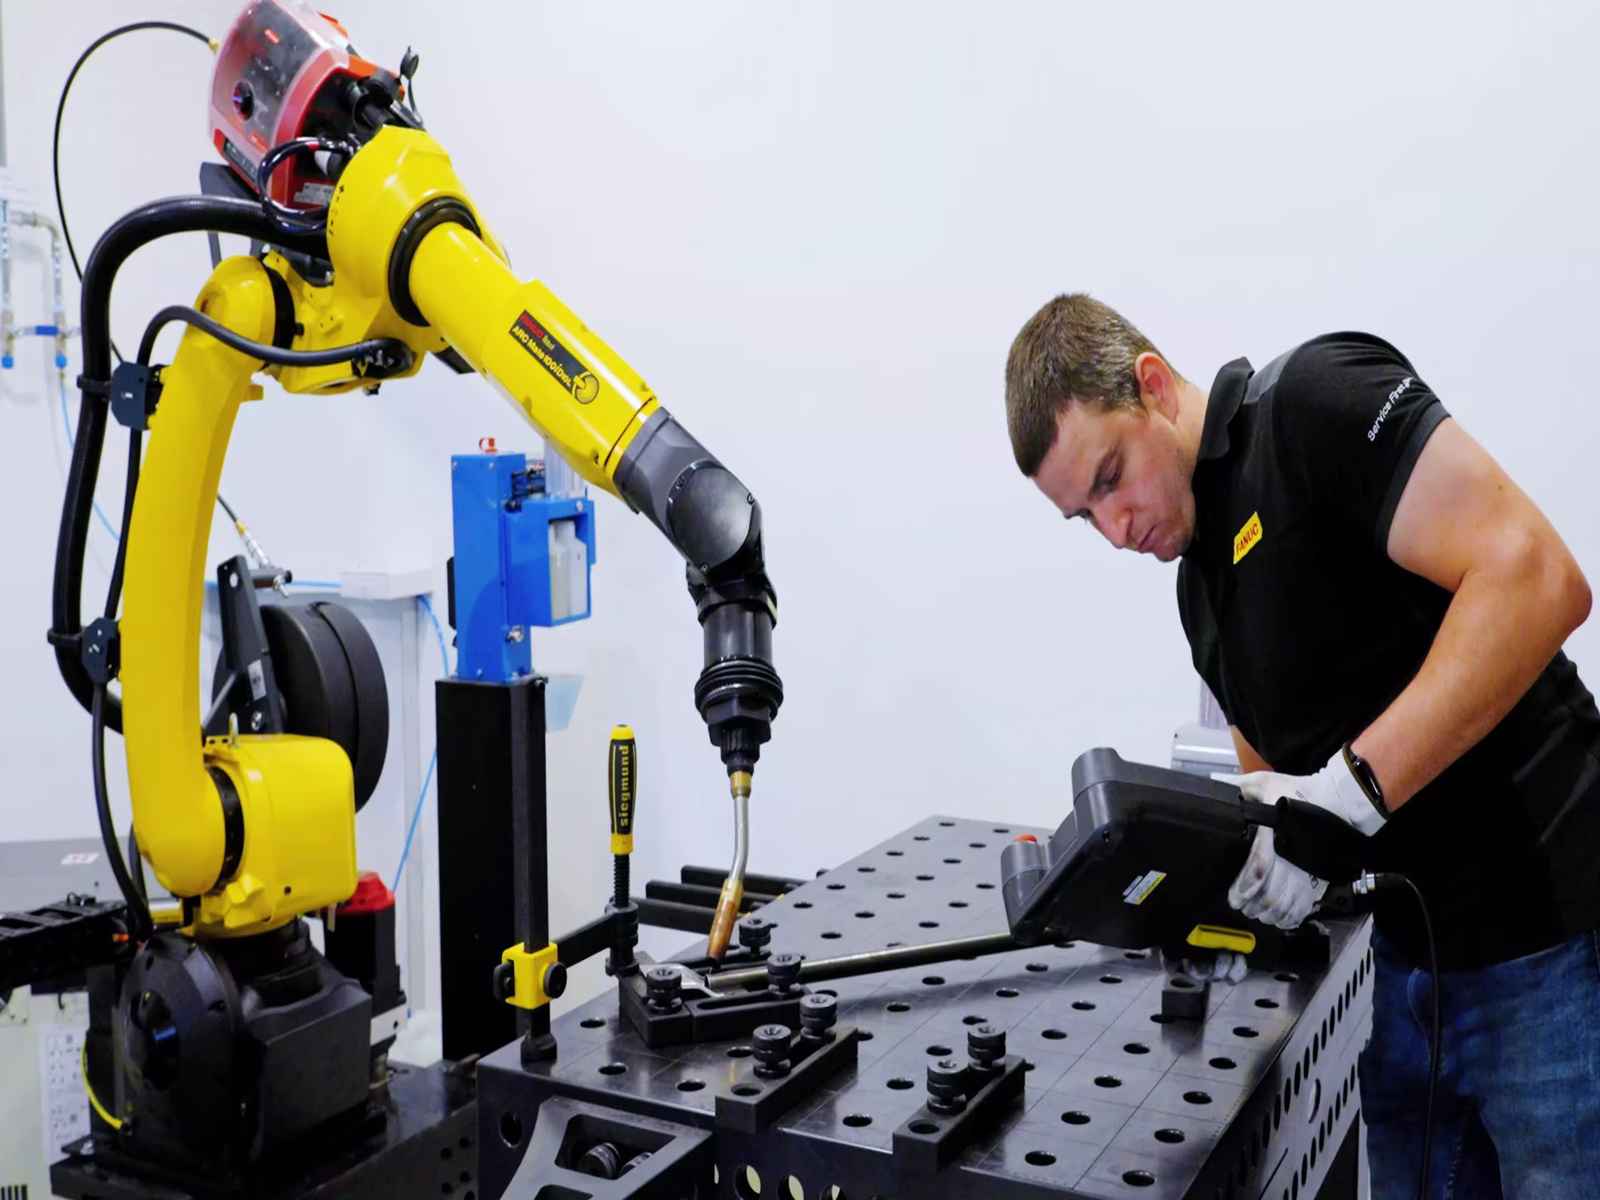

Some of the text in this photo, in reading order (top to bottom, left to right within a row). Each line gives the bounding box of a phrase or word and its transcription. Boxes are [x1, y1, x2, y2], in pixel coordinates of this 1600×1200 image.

[1367, 401, 1392, 442] Service
[1236, 522, 1259, 556] FANUC
[619, 744, 631, 827] siegmund
